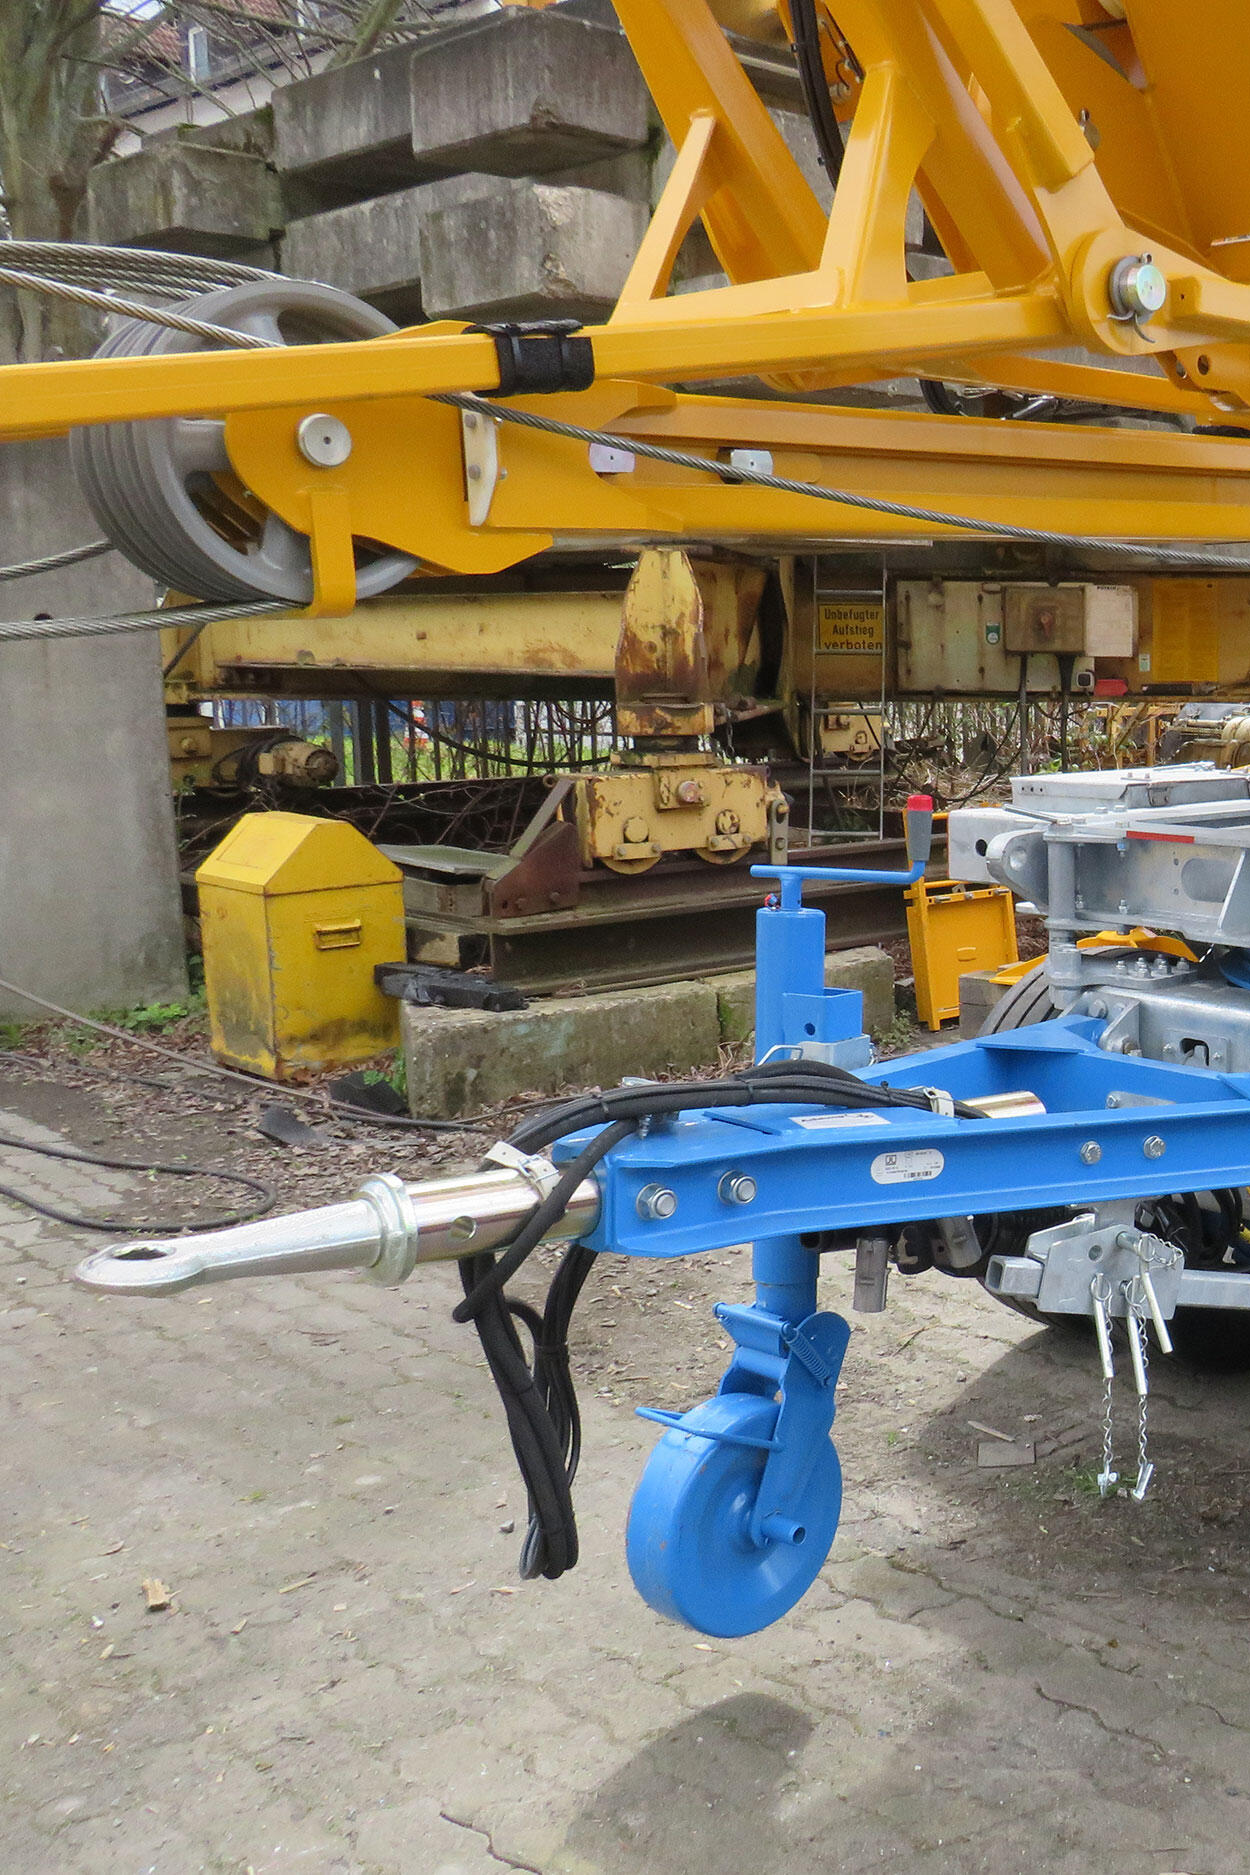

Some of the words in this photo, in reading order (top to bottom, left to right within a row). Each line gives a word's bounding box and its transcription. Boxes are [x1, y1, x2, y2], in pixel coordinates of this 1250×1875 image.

[824, 608, 879, 622] Unbefugter
[832, 624, 874, 637] Aufstieg
[824, 639, 882, 650] verboten
